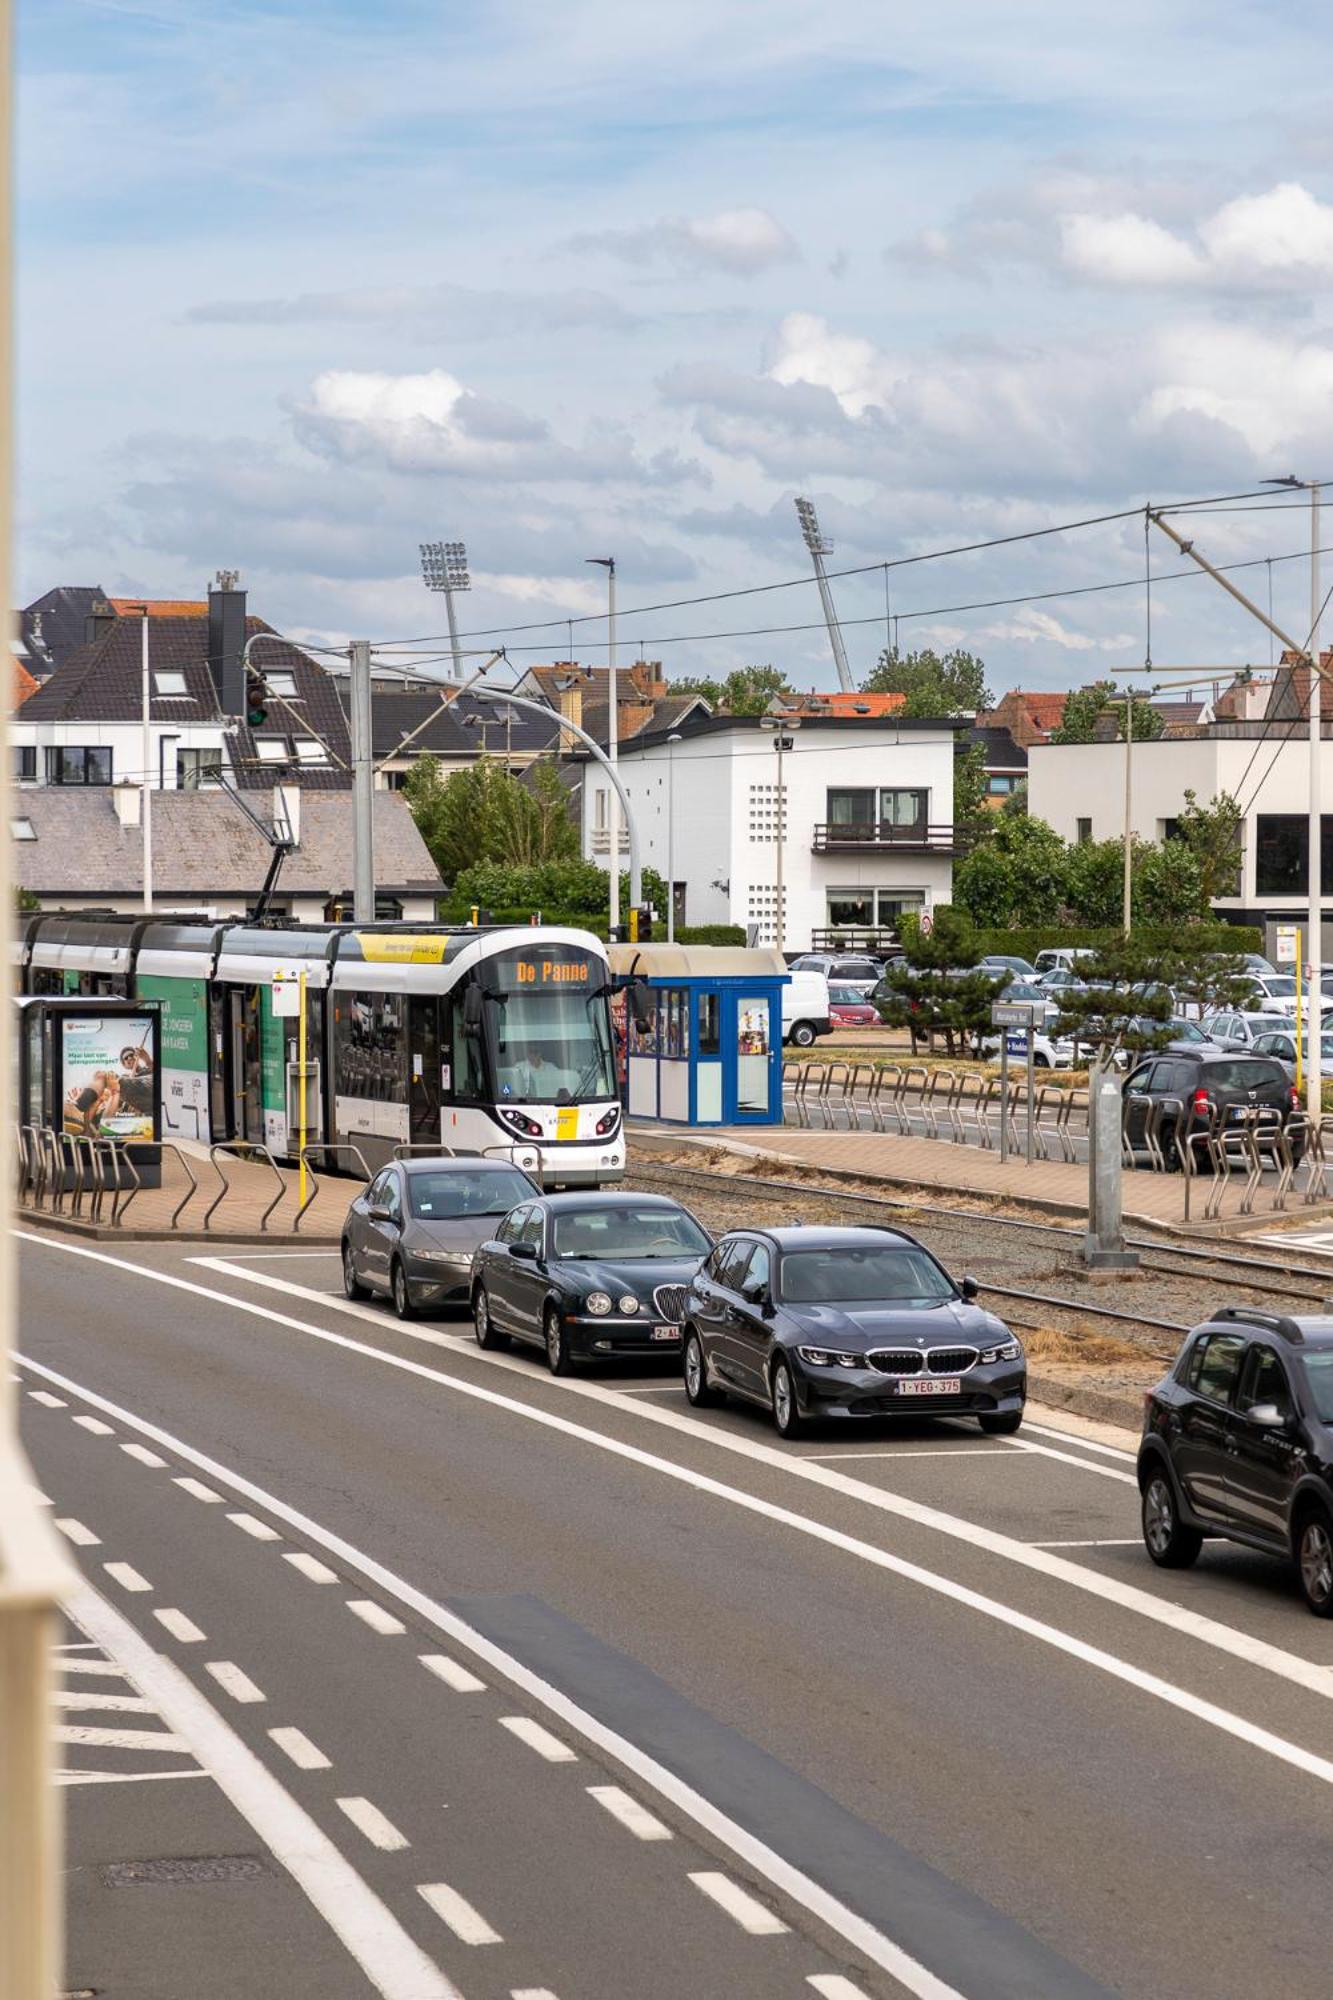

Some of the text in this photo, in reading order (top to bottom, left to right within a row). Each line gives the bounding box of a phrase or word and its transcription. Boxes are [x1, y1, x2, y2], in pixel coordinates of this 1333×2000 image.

[517, 961, 588, 982] De Panne
[902, 1381, 960, 1393] 1-YEG-375
